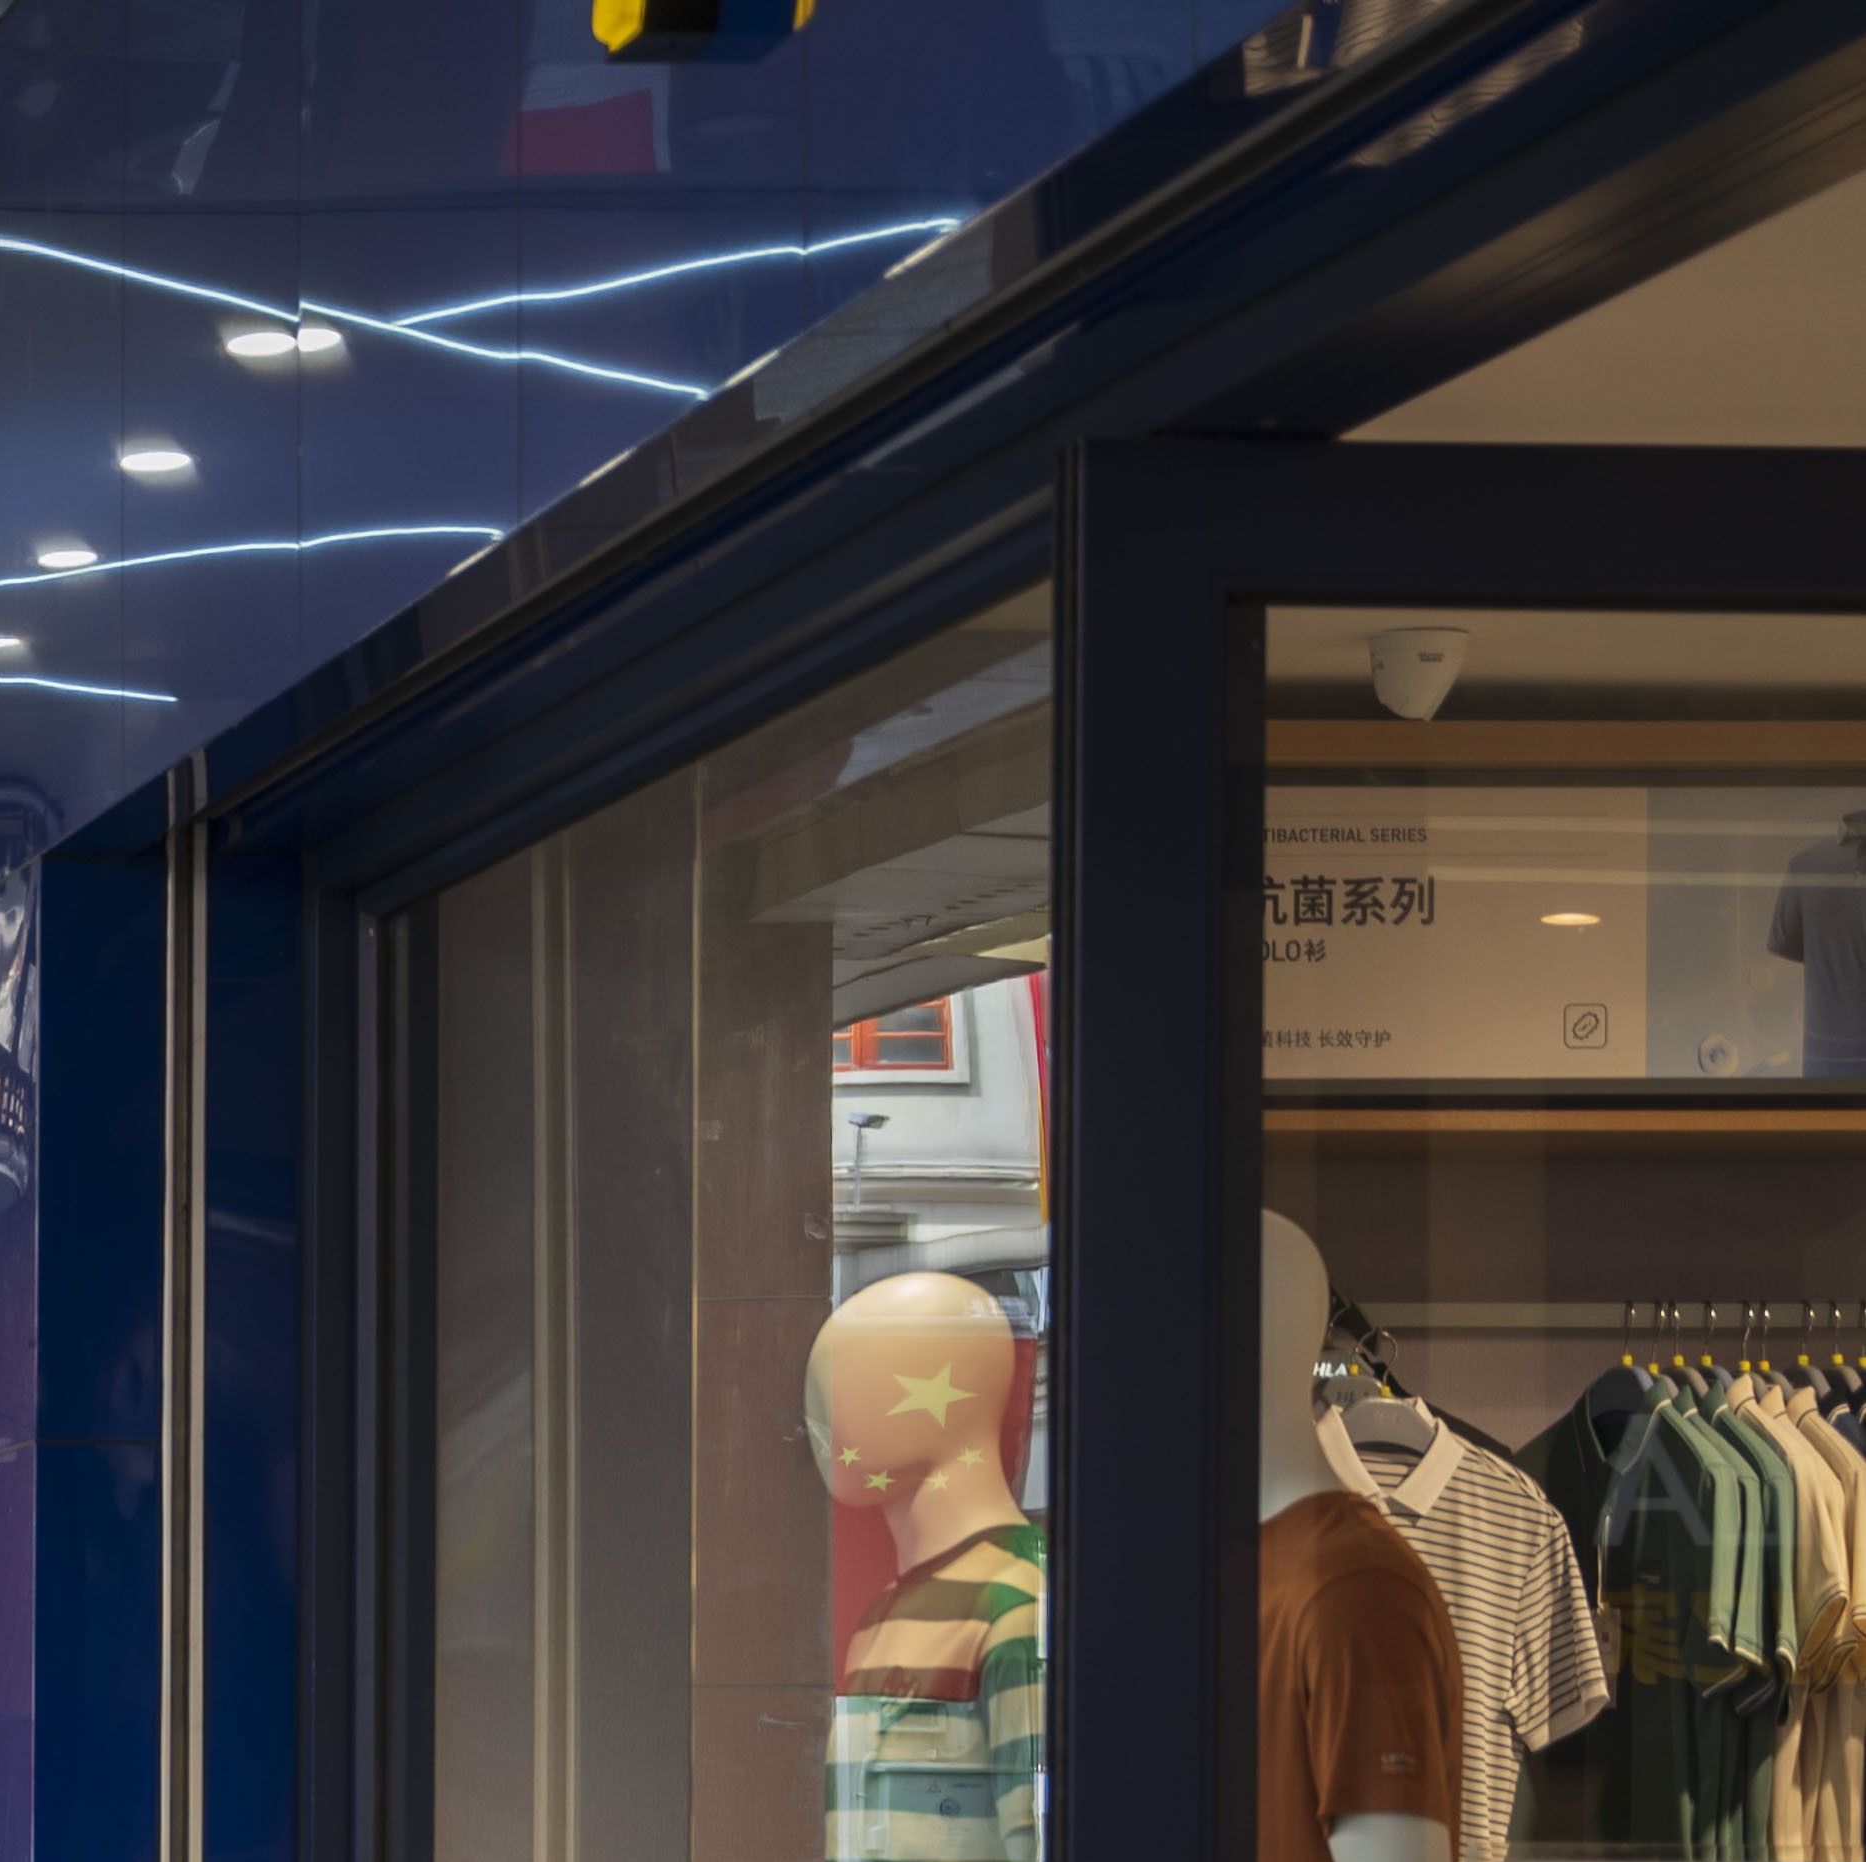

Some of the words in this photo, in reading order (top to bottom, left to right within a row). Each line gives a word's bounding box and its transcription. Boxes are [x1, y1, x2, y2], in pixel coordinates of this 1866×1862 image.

[1370, 827, 1428, 843] SERIES
[1319, 1029, 1391, 1048] 长效守护
